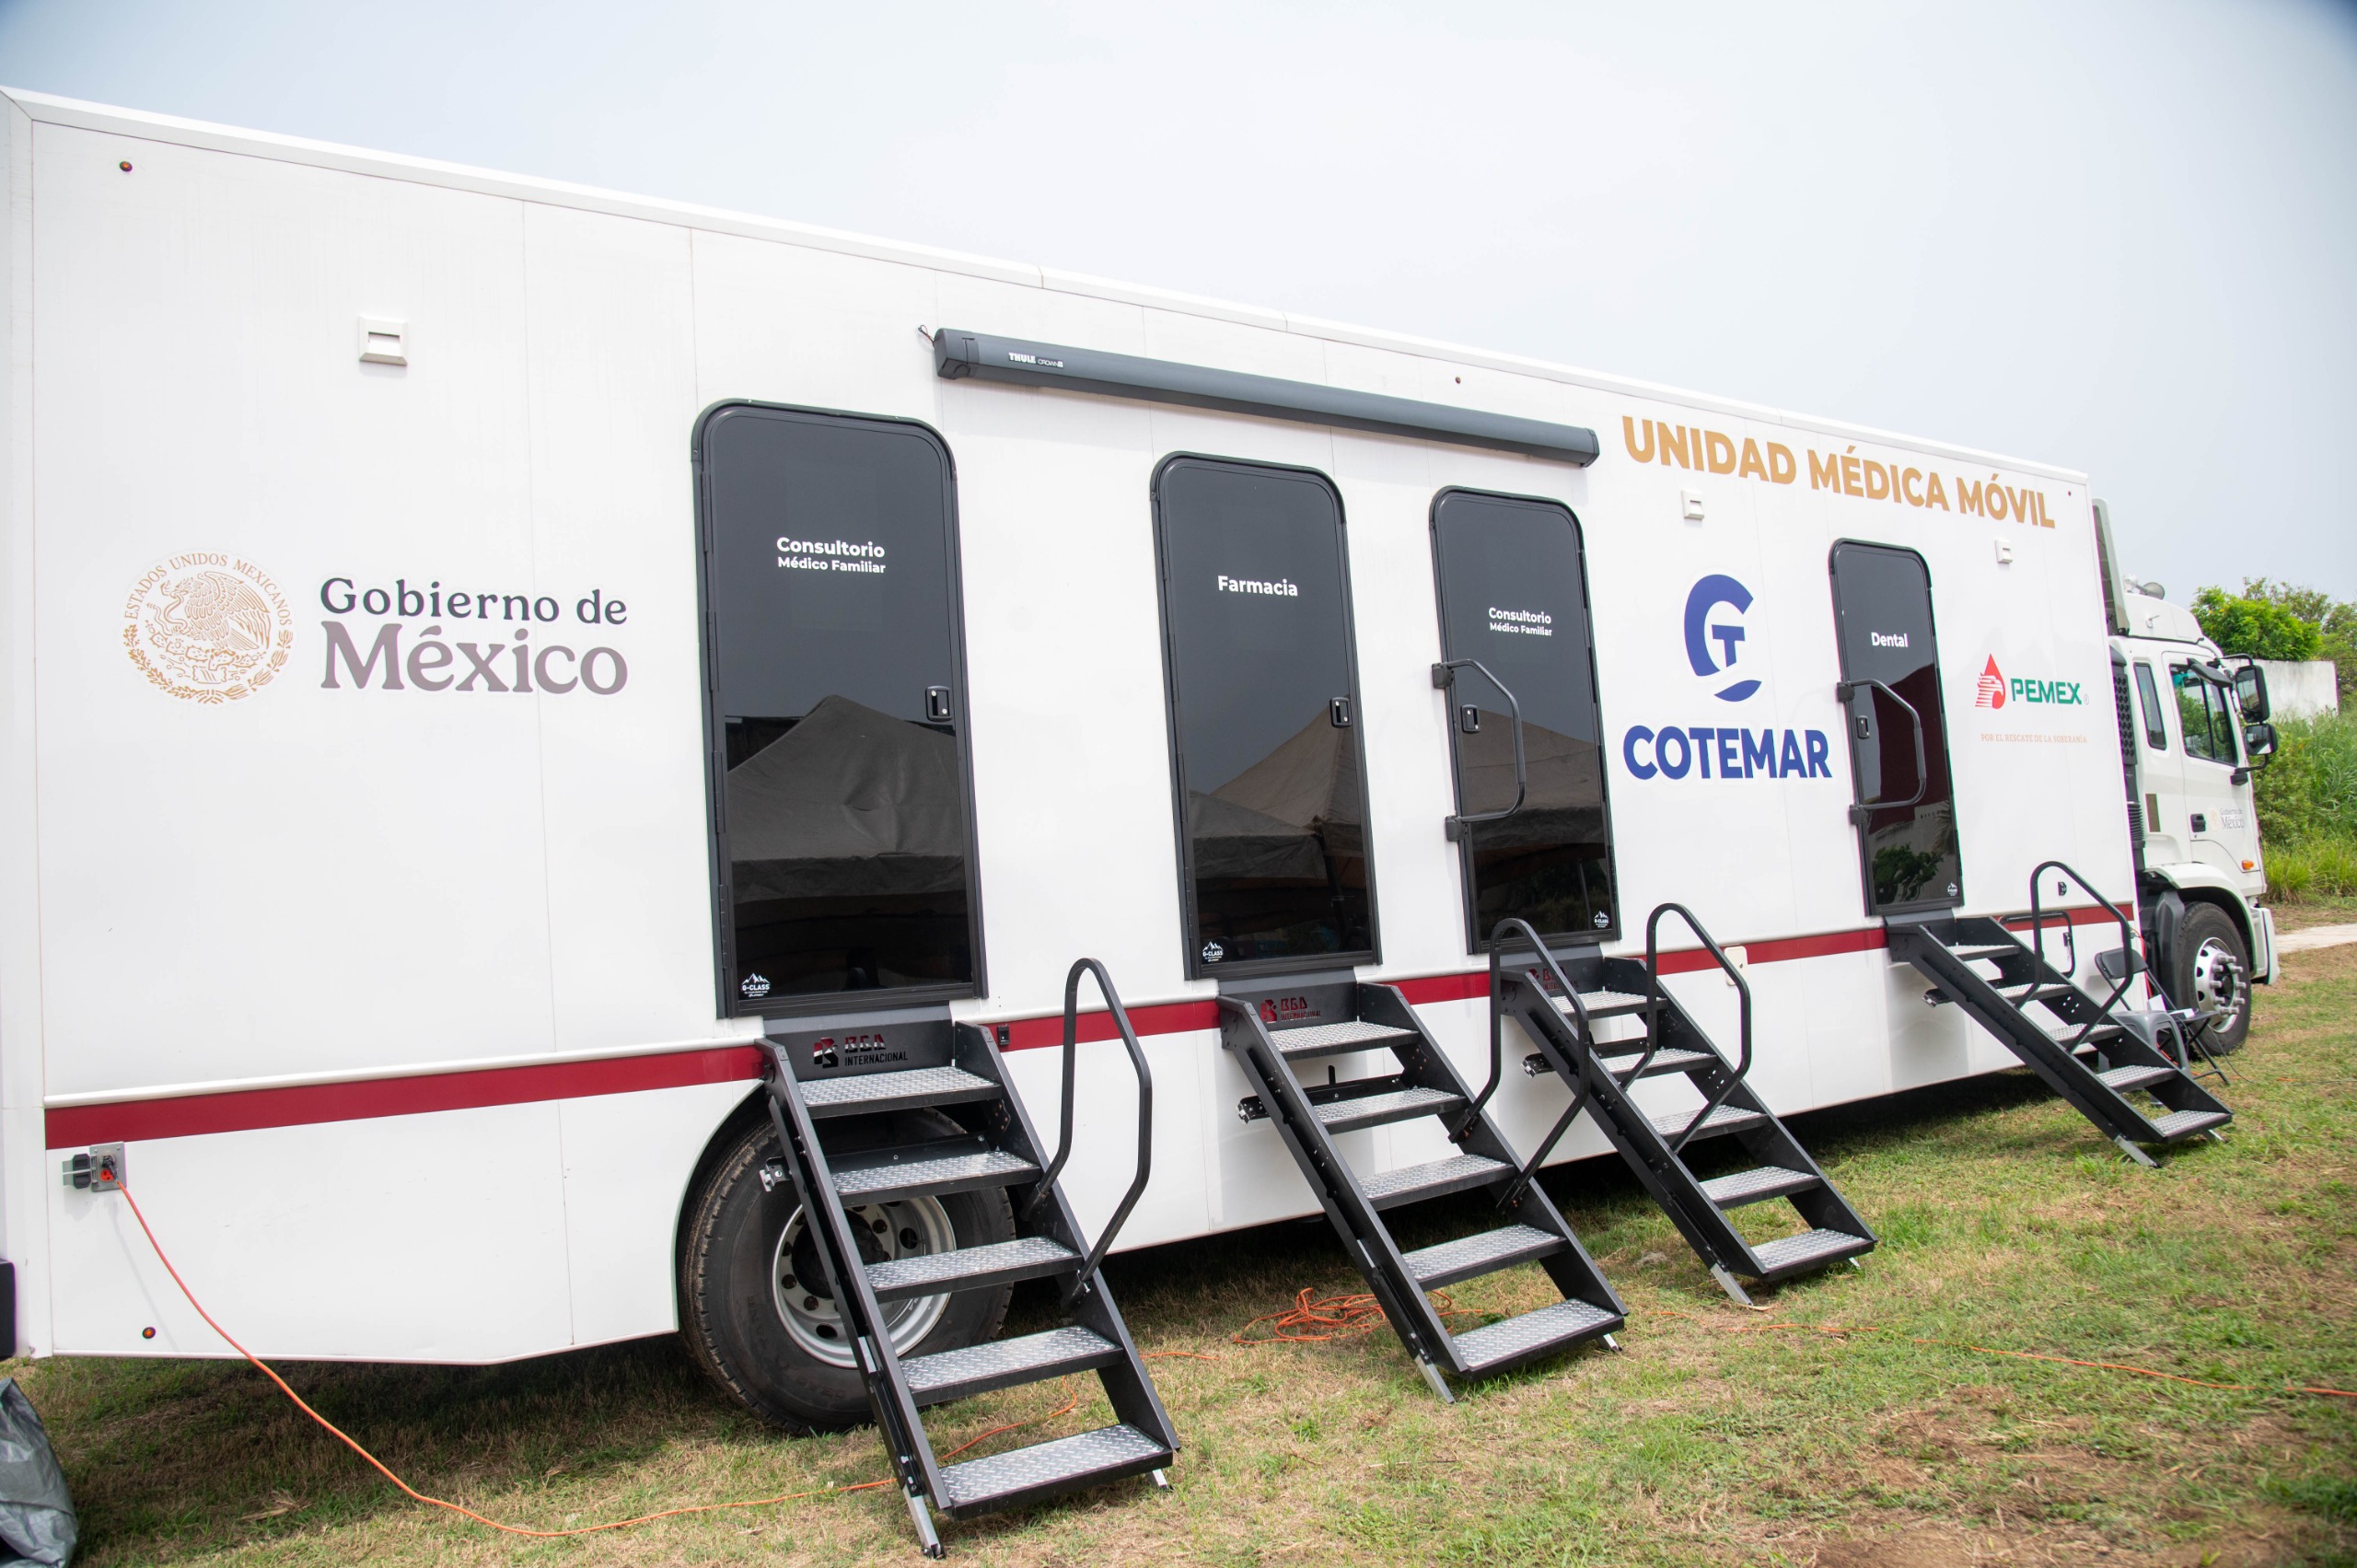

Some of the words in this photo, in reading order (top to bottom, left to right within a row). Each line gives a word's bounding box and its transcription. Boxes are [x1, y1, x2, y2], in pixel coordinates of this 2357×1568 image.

[1008, 352, 1036, 365] THULE
[1622, 415, 1796, 485] UNIDAD
[1807, 446, 1950, 512] MÉDICA
[1956, 473, 2055, 528] MÓVIL
[776, 537, 886, 558] Consultorio
[778, 556, 829, 571] Médico
[831, 560, 886, 574] Familiar
[124, 565, 168, 620] ESTADOS
[169, 552, 227, 570] UNIDOS
[233, 559, 293, 626] MEXICANOS
[1217, 575, 1298, 597] Farmacia
[321, 577, 560, 622] Gobierno
[577, 589, 627, 625] de
[1488, 607, 1552, 624] Consultorio
[1490, 621, 1519, 633] Médico
[1520, 625, 1552, 636] Familiar
[1871, 632, 1909, 648] Dental
[320, 621, 628, 695] México
[2011, 678, 2082, 705] PEMEX
[1980, 733, 1994, 742] POR
[1995, 734, 2004, 742] EL
[2005, 734, 2033, 743] RESCATE
[2034, 735, 2042, 743] DE
[1622, 725, 1833, 781] COTEMAR
[1281, 996, 1308, 1012] BGA
[844, 1051, 909, 1066] INTERNACIONAL
